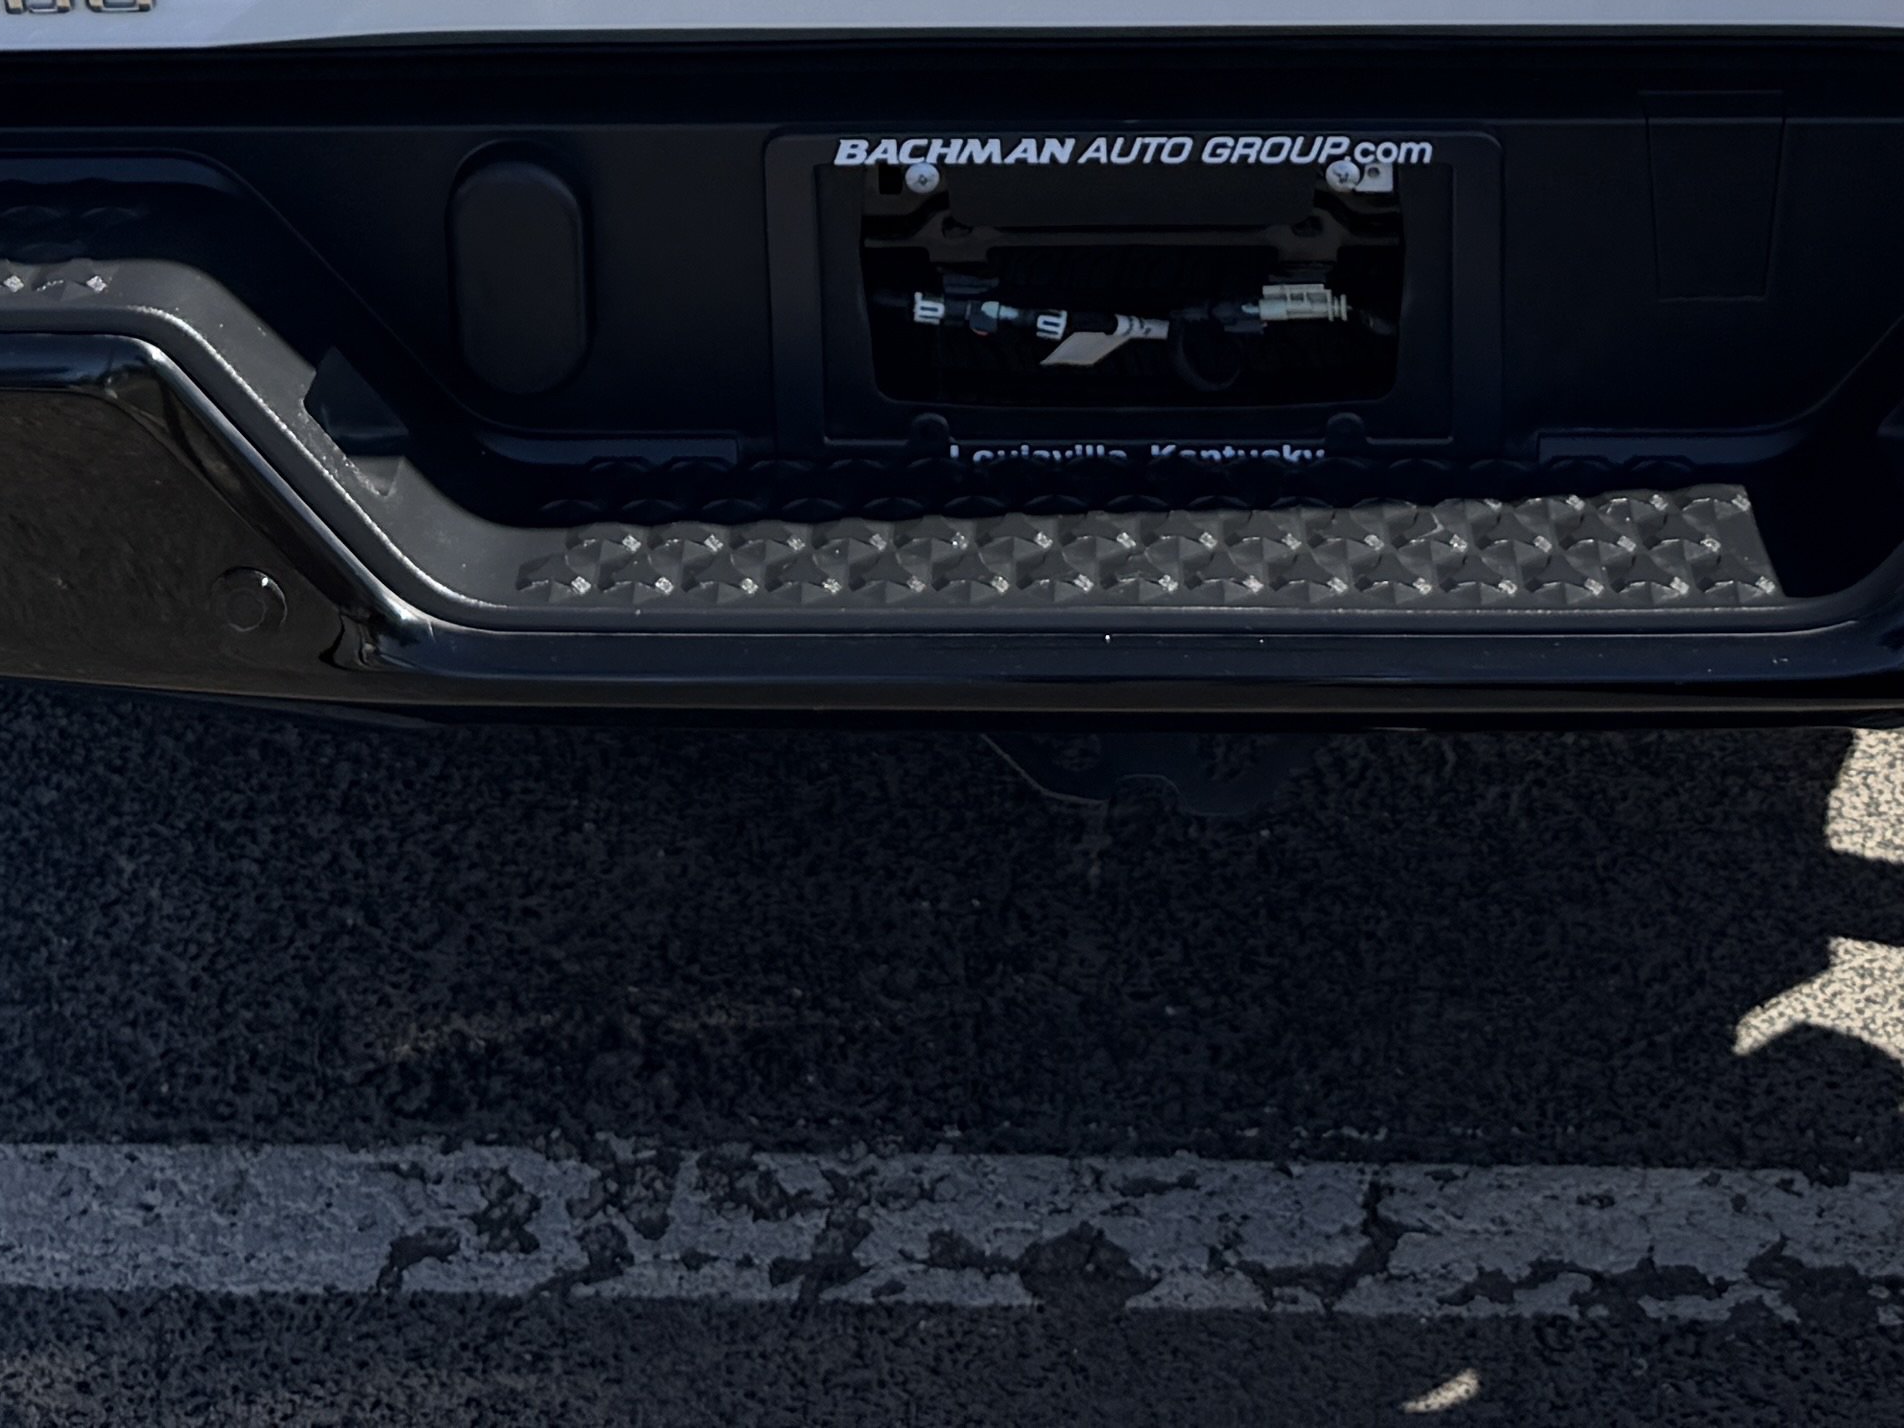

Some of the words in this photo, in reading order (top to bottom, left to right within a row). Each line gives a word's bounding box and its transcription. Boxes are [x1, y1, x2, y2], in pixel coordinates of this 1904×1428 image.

[834, 138, 1075, 165] BACHMAN
[1077, 136, 1194, 165] AUTO
[1201, 135, 1433, 165] GROUP.com
